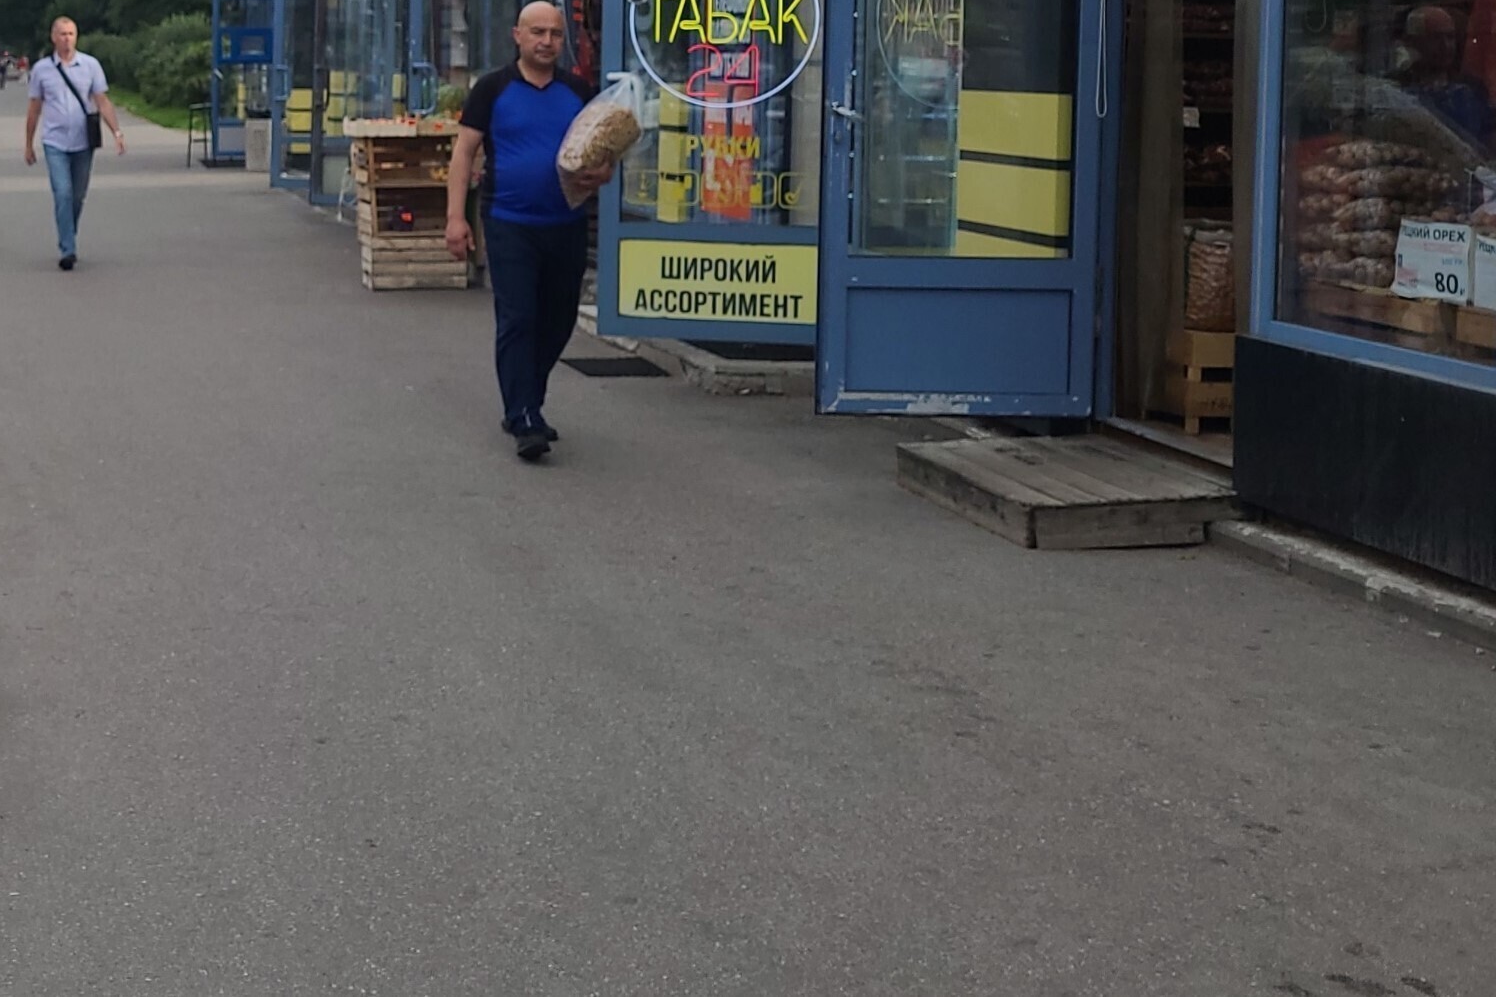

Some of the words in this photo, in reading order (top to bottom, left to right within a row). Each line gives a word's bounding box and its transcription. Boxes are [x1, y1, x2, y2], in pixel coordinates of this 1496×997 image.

[687, 44, 760, 97] 24
[1432, 228, 1465, 243] ОРЕХ
[660, 254, 777, 284] ШИРОКИЙ
[1434, 272, 1459, 295] 80
[634, 288, 803, 319] АССОРТИМЕНТ
